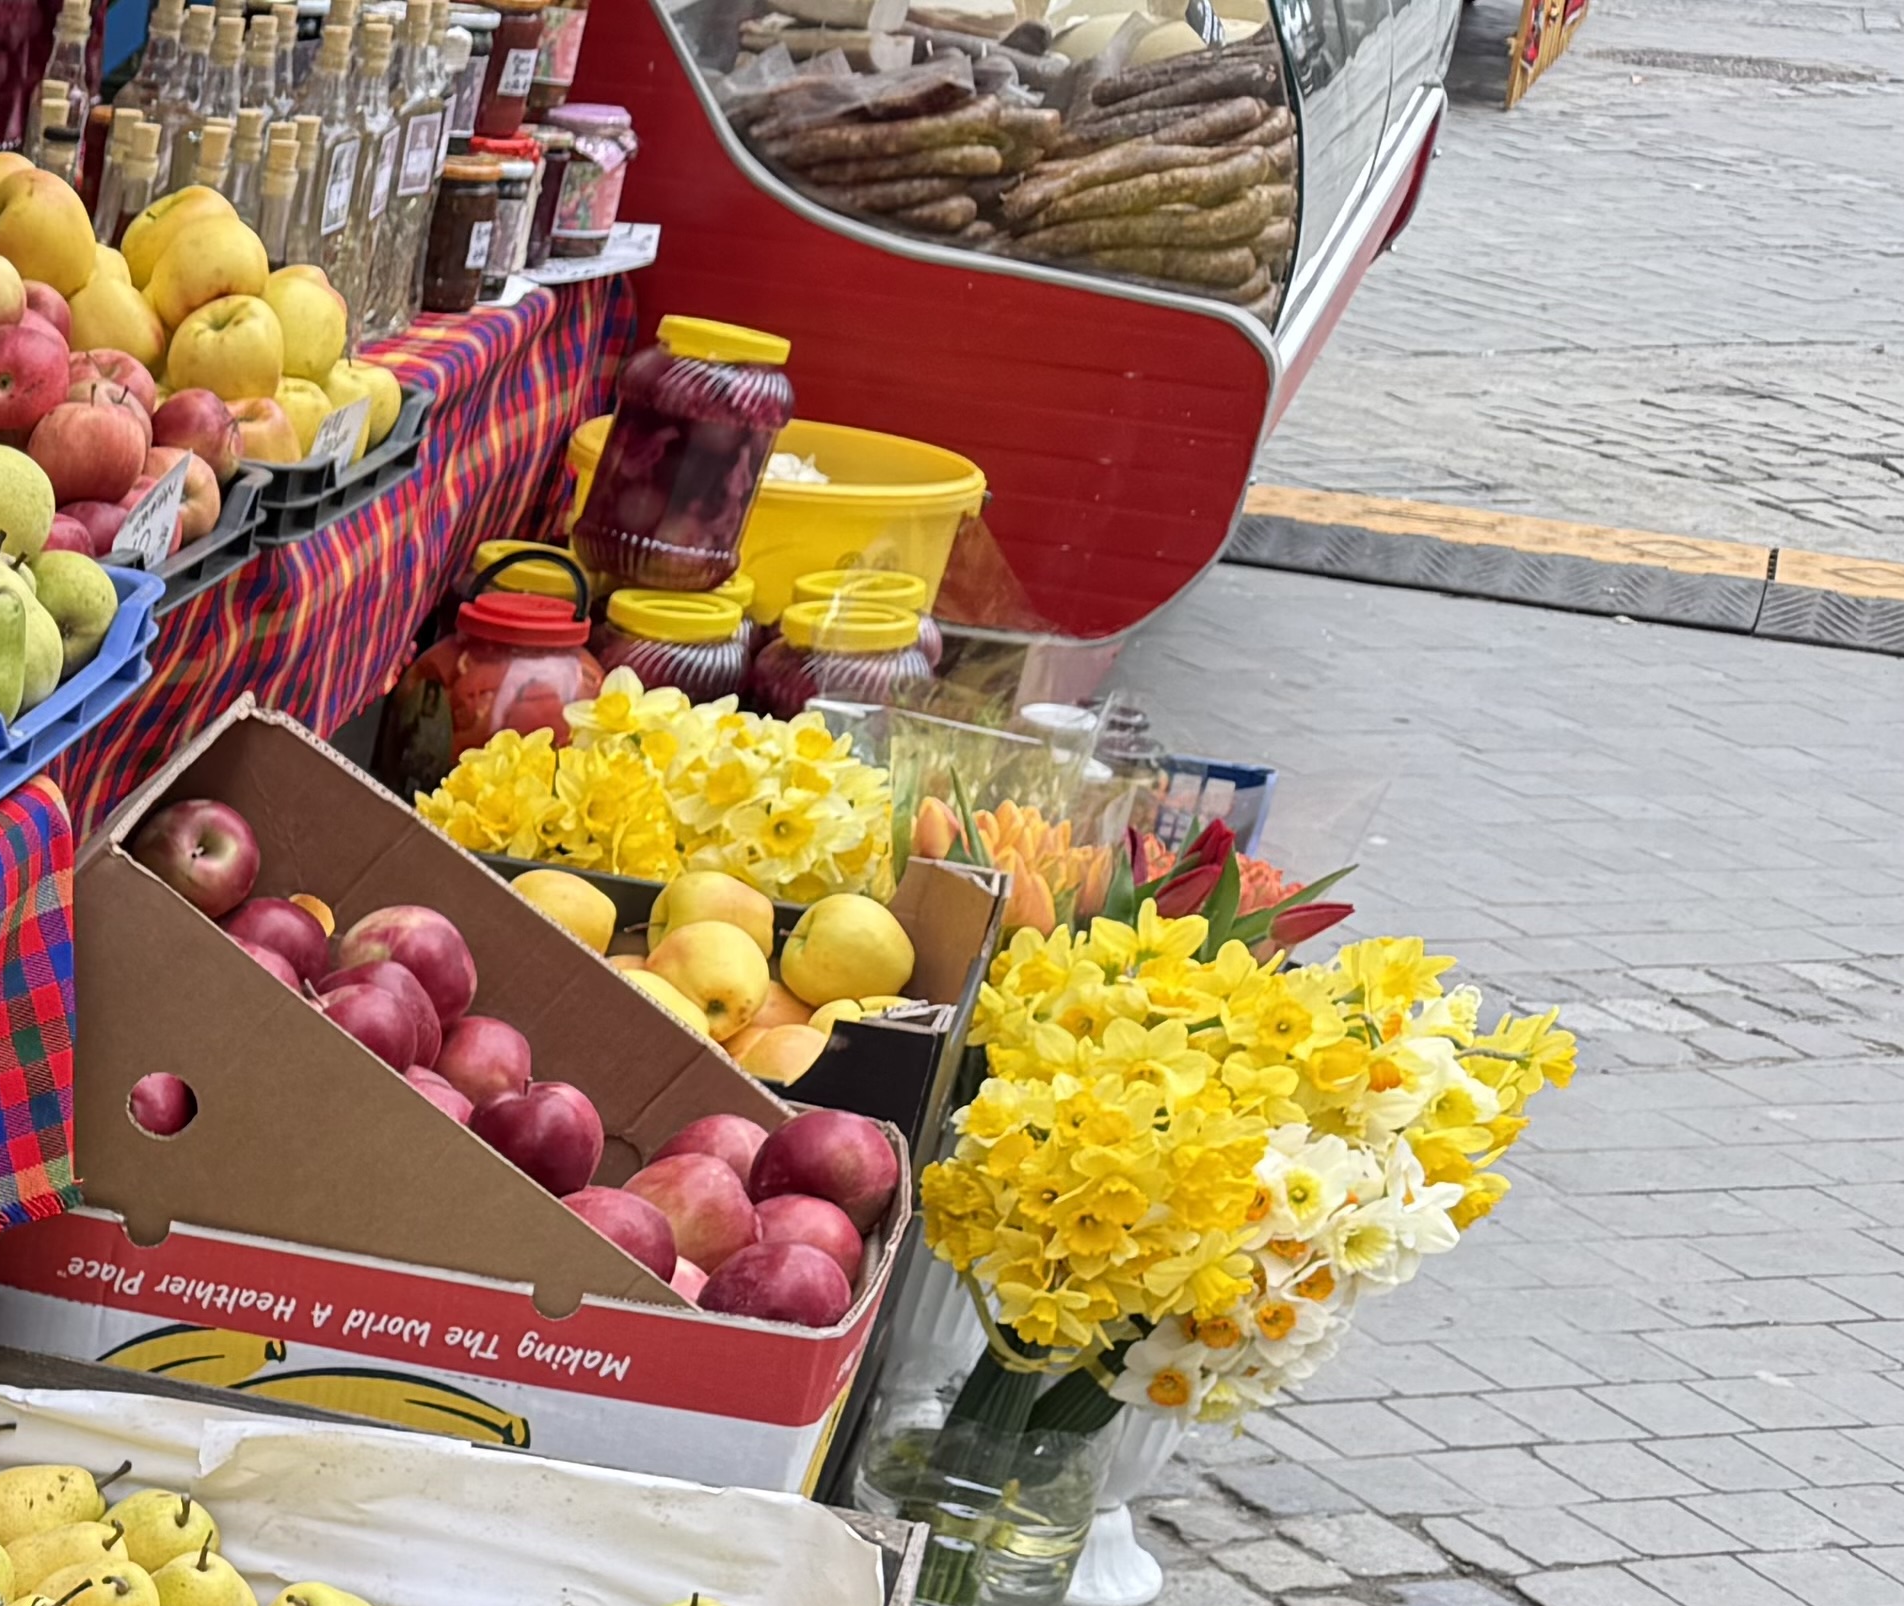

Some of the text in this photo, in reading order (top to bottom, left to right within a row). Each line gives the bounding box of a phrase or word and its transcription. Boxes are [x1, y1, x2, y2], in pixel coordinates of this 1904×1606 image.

[154, 1273, 297, 1323] Healthier
[311, 1301, 333, 1328] A
[341, 1308, 432, 1348] World
[444, 1325, 499, 1360] The
[517, 1330, 631, 1381] Making
